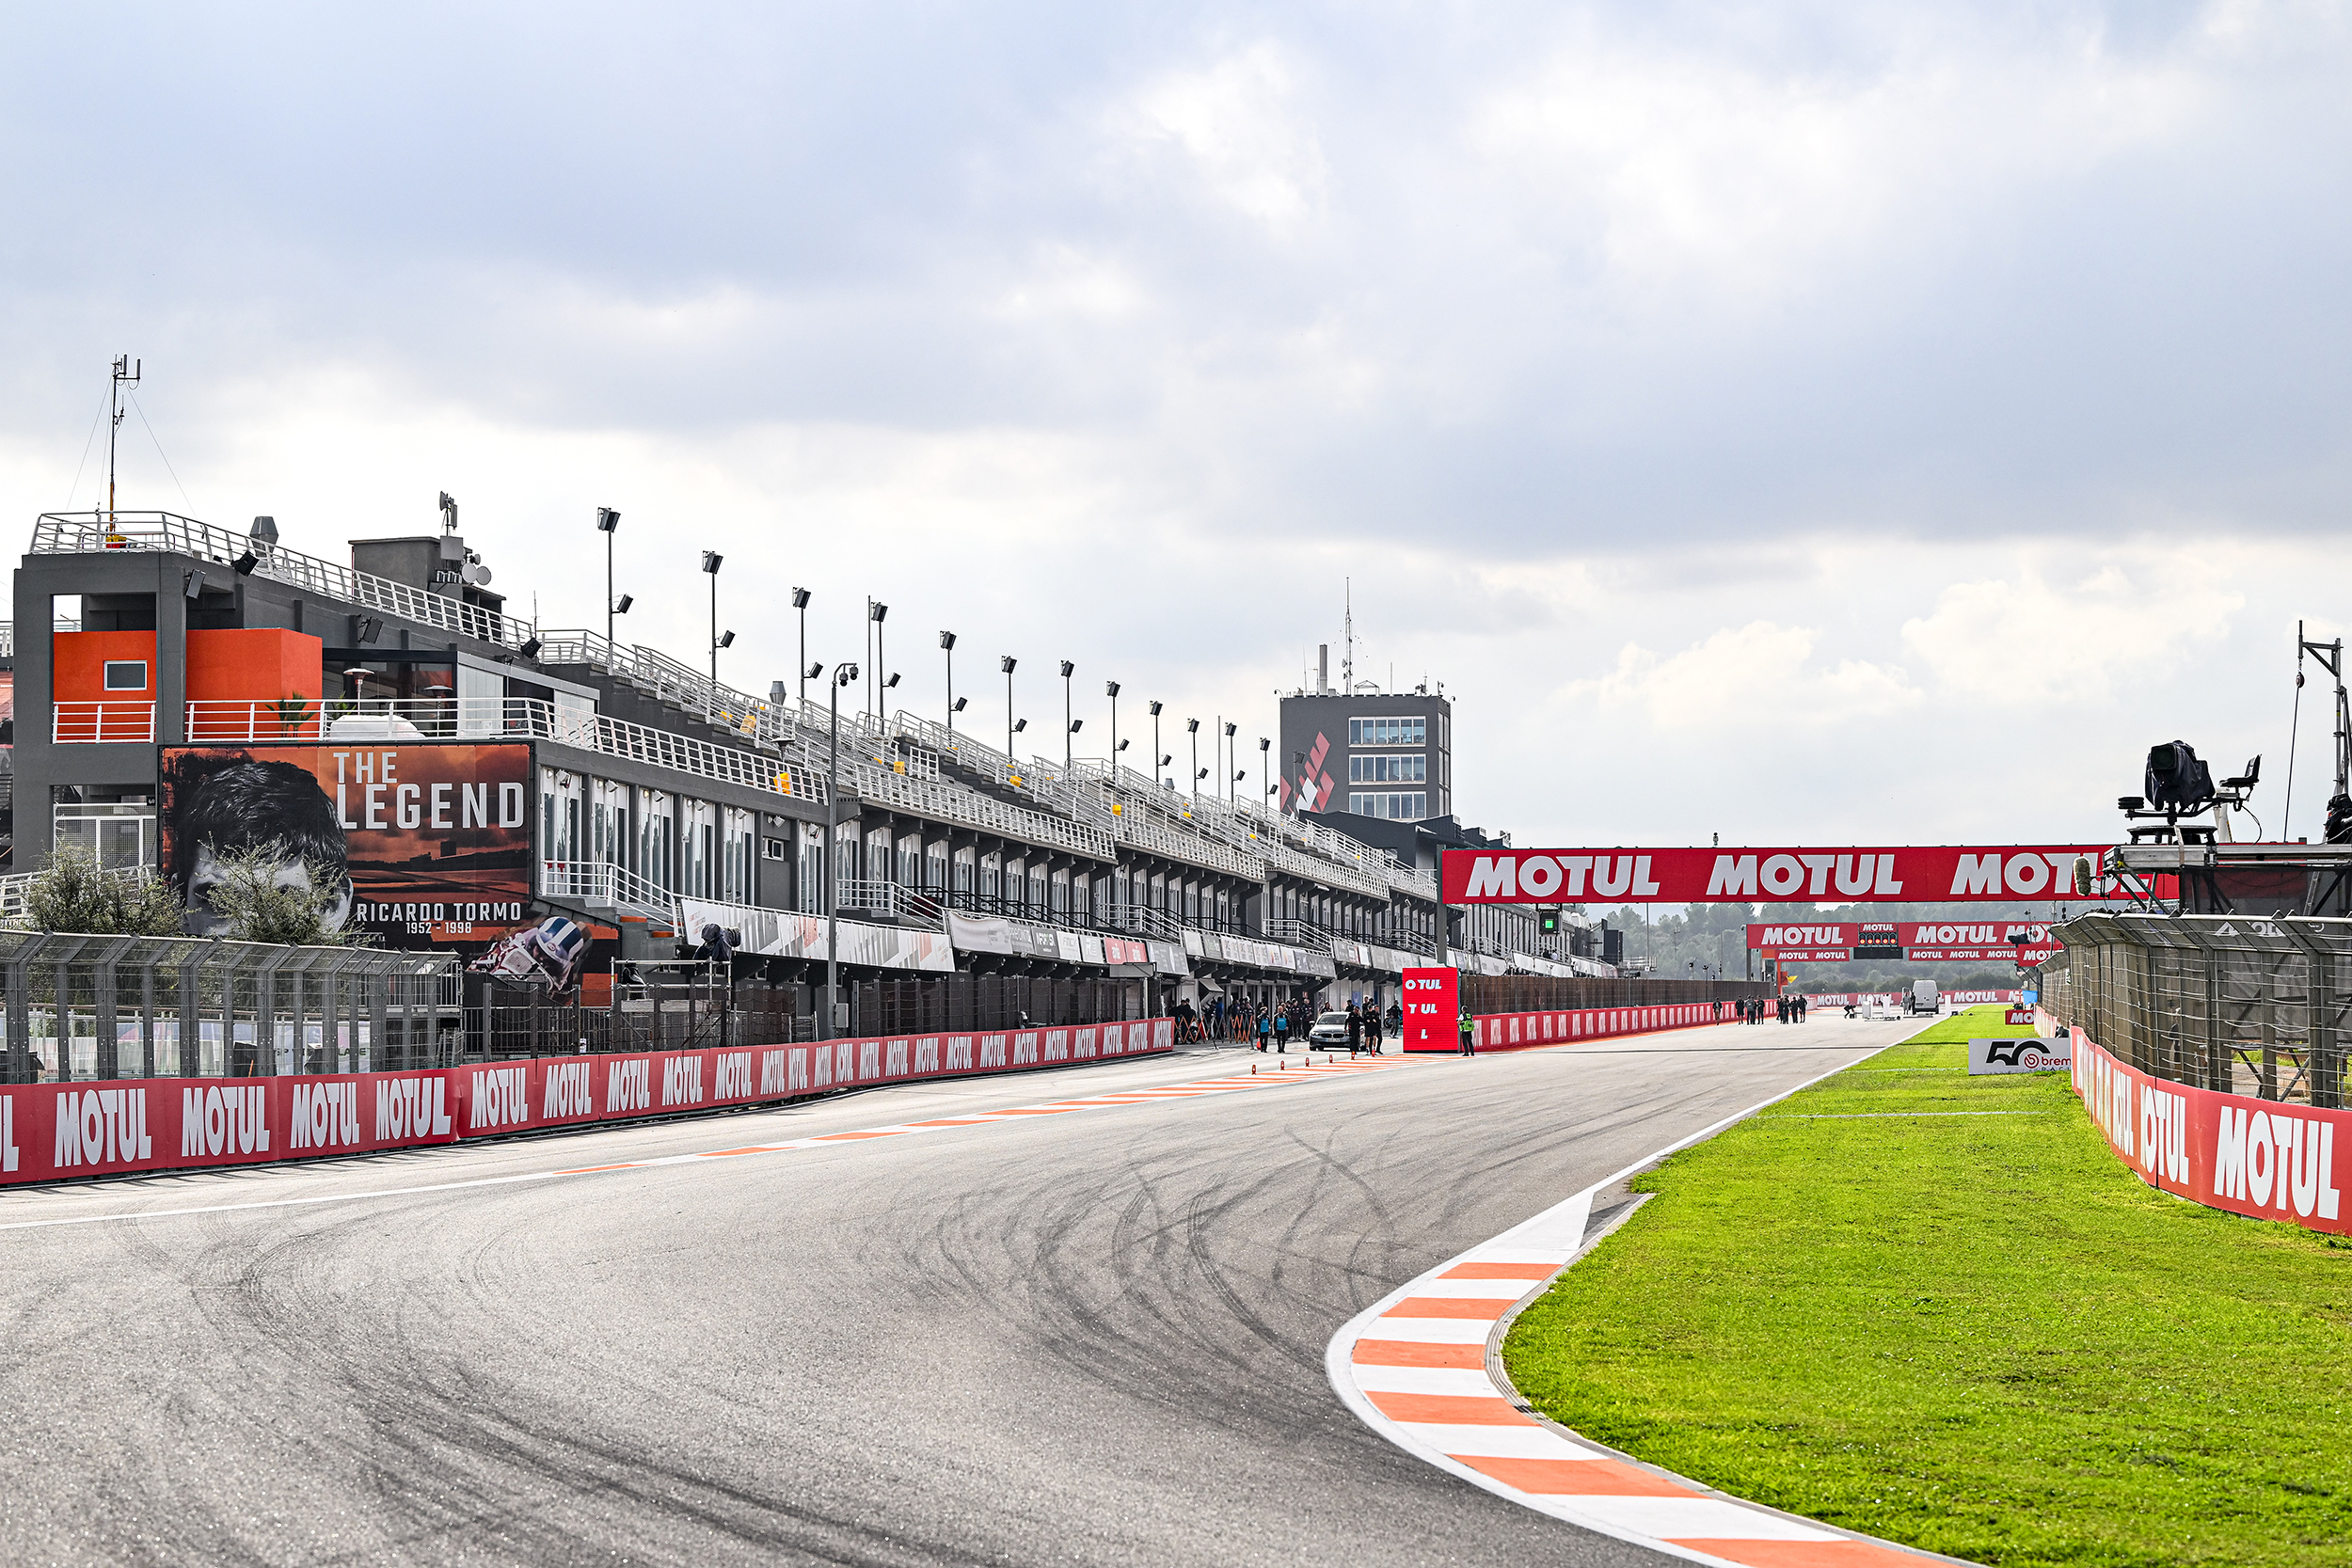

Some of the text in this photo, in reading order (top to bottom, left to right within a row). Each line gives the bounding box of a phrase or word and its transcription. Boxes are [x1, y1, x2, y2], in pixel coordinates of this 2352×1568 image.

[333, 752, 398, 784] THE
[336, 783, 525, 830] LEGEND
[1465, 855, 1661, 897] MOTUL
[1706, 853, 1904, 896] MOTUL
[357, 902, 522, 923] RICARDO TORMO
[405, 922, 432, 934] 1952
[445, 922, 472, 934] 1998
[1761, 927, 1844, 945] MOTUL
[1915, 925, 1997, 943] MOTUL
[1949, 950, 1980, 958] MOTUL
[1418, 979, 1442, 990] TUL
[1817, 995, 1850, 1006] MOTUL
[1857, 994, 1894, 1005] MOTL
[1954, 991, 1997, 1002] MOTUL
[1421, 1004, 1438, 1014] UL
[1421, 1029, 1428, 1039] L
[55, 1088, 151, 1167] MOTUL
[182, 1085, 270, 1156] MOTUL
[290, 1082, 359, 1148] MOTUL
[376, 1077, 452, 1140] MOTUL
[470, 1068, 529, 1129] MOTUL
[543, 1063, 592, 1118] MOTUL
[606, 1059, 650, 1113] MOTUL
[661, 1055, 703, 1106] MOTUL
[714, 1053, 752, 1101] MOTUL
[760, 1050, 785, 1095] MOTUL
[859, 1042, 880, 1080] MOTUL
[885, 1040, 908, 1076] MOTUL
[914, 1037, 939, 1073] MOTUL
[946, 1036, 972, 1069] MOTUL
[980, 1034, 1006, 1068] MOTUL
[1013, 1032, 1038, 1065] MOTUL
[1044, 1029, 1068, 1061] MOTUL
[1074, 1028, 1096, 1058] MOTUL
[1103, 1025, 1122, 1054] MOTUL
[1128, 1022, 1148, 1052] MOTUL
[1153, 1021, 1171, 1048] MOTUL
[2214, 1105, 2341, 1221] MOTUL
